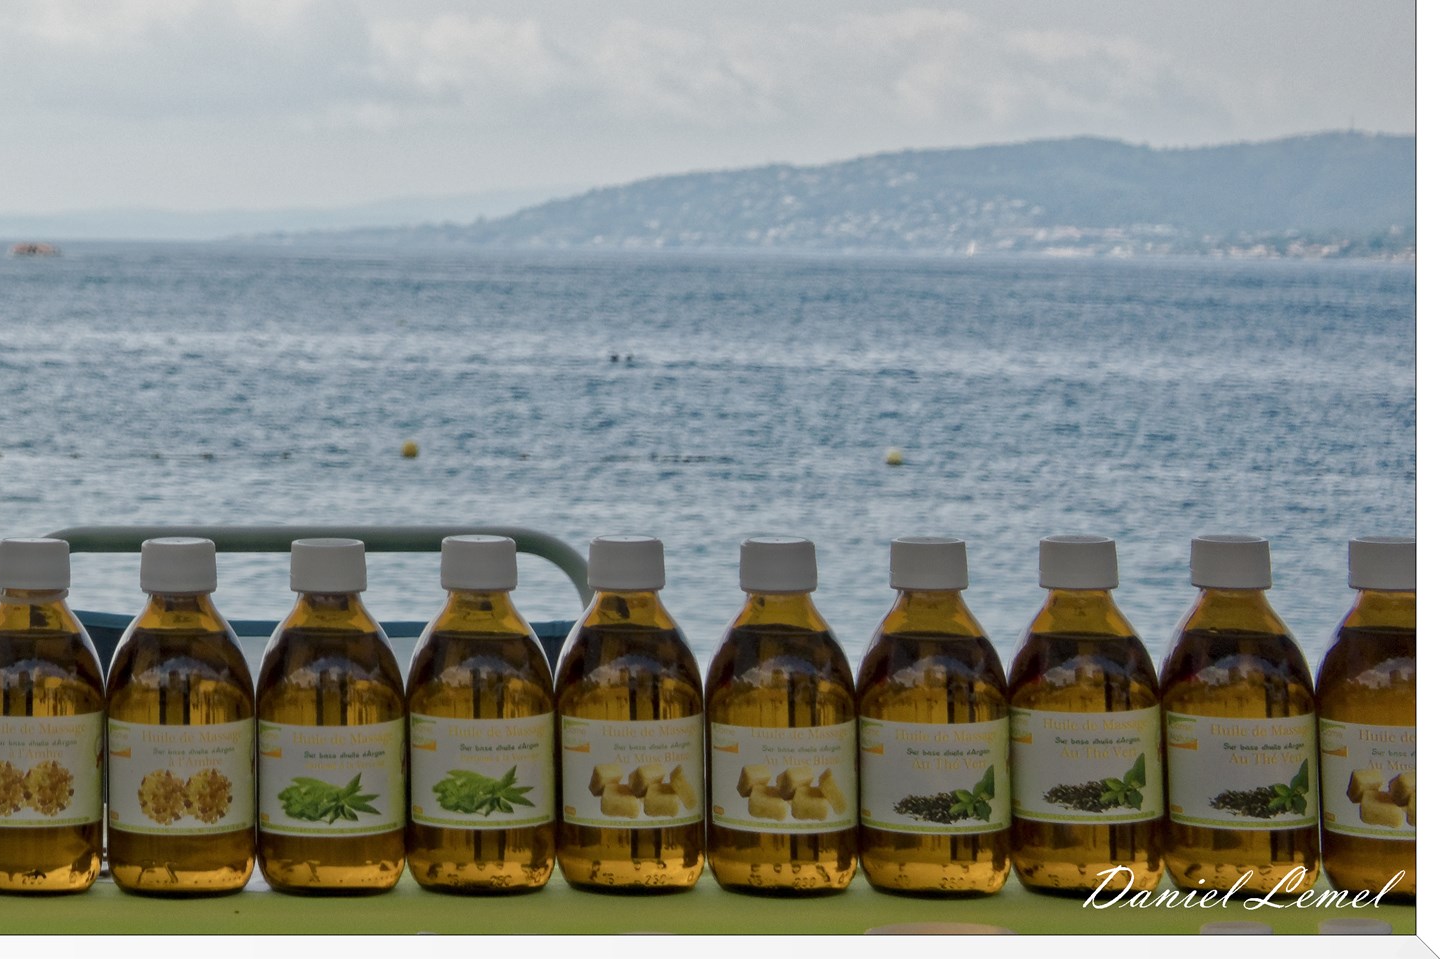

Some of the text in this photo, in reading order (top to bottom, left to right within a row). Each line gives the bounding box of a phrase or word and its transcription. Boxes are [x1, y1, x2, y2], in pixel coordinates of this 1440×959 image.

[20, 723, 33, 733] de
[1082, 720, 1098, 730] de
[487, 727, 502, 737] de
[640, 726, 654, 737] de
[790, 729, 802, 739] de
[1252, 726, 1267, 736] de
[1359, 729, 1396, 742] Huile
[1400, 731, 1415, 742] de
[180, 732, 193, 742] de
[330, 734, 345, 745] de
[934, 732, 950, 742] de
